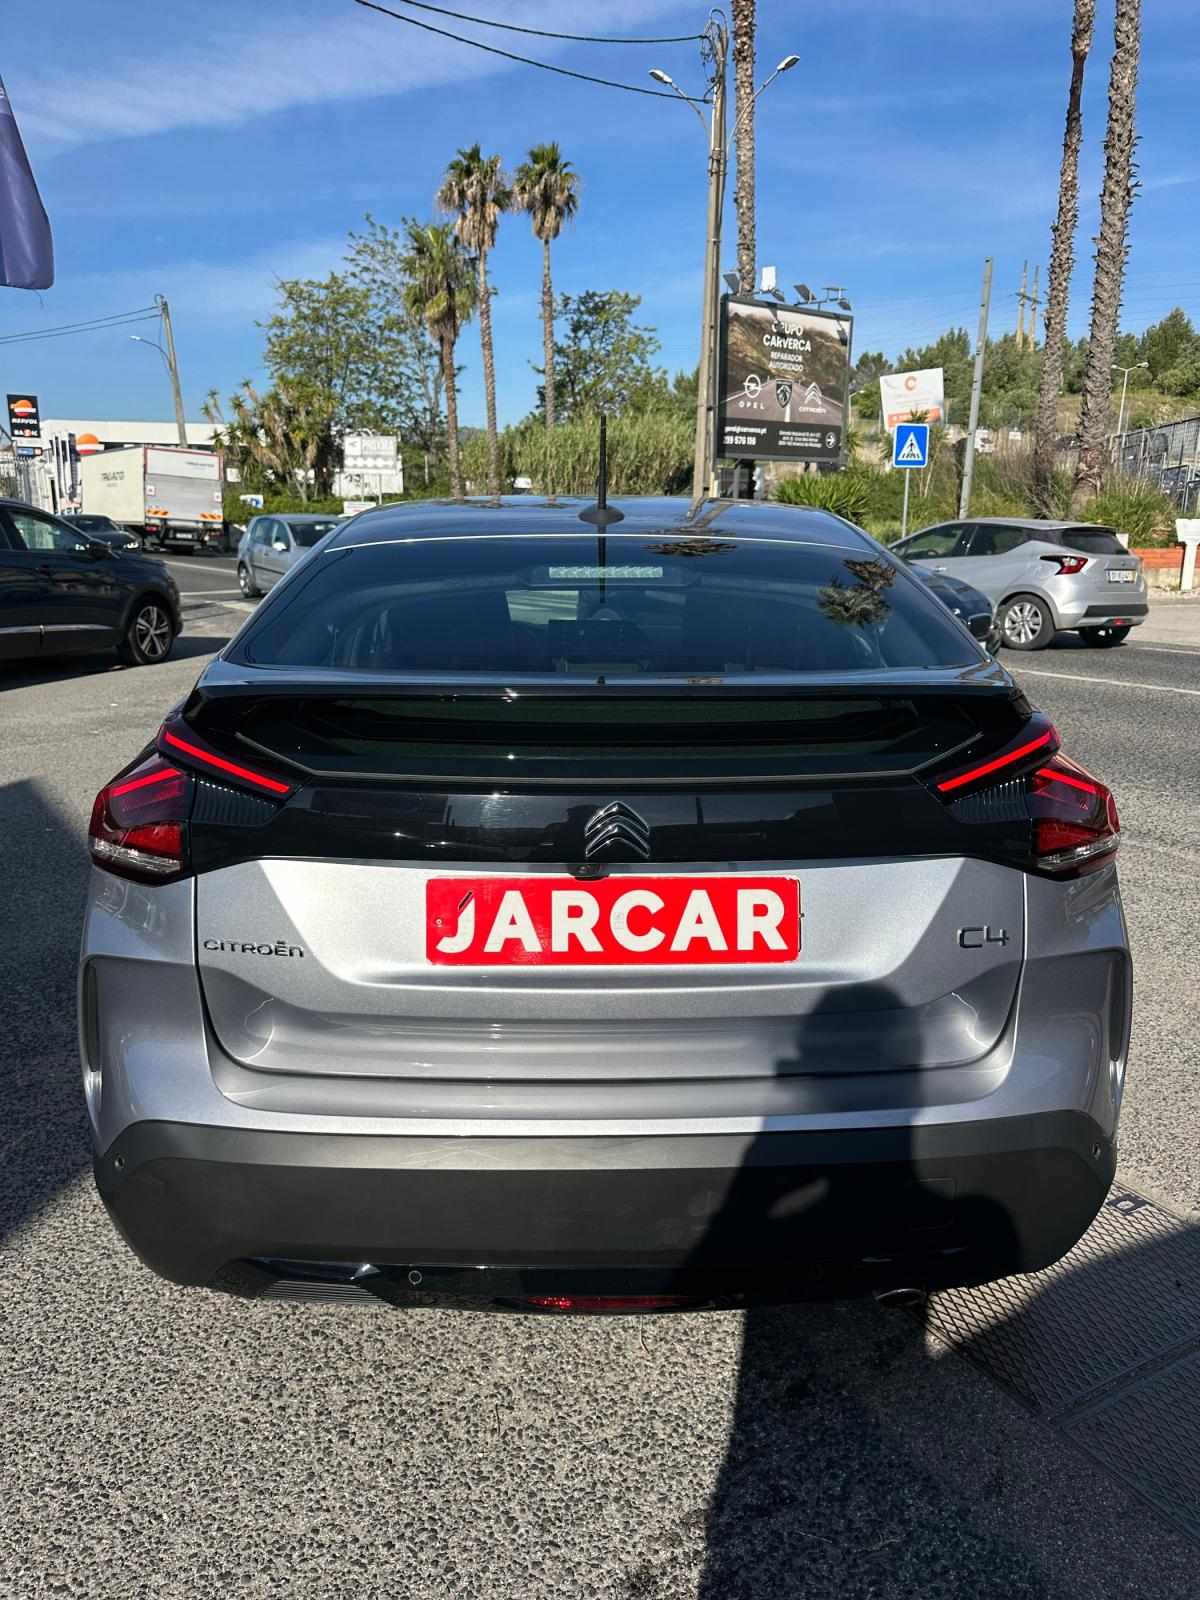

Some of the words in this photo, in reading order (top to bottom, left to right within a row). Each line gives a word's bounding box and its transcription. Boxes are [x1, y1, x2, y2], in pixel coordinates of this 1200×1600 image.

[763, 334, 812, 352] CARVERCA
[738, 400, 765, 410] OPEL
[435, 888, 788, 954] JARCAR
[957, 926, 1010, 949] C4
